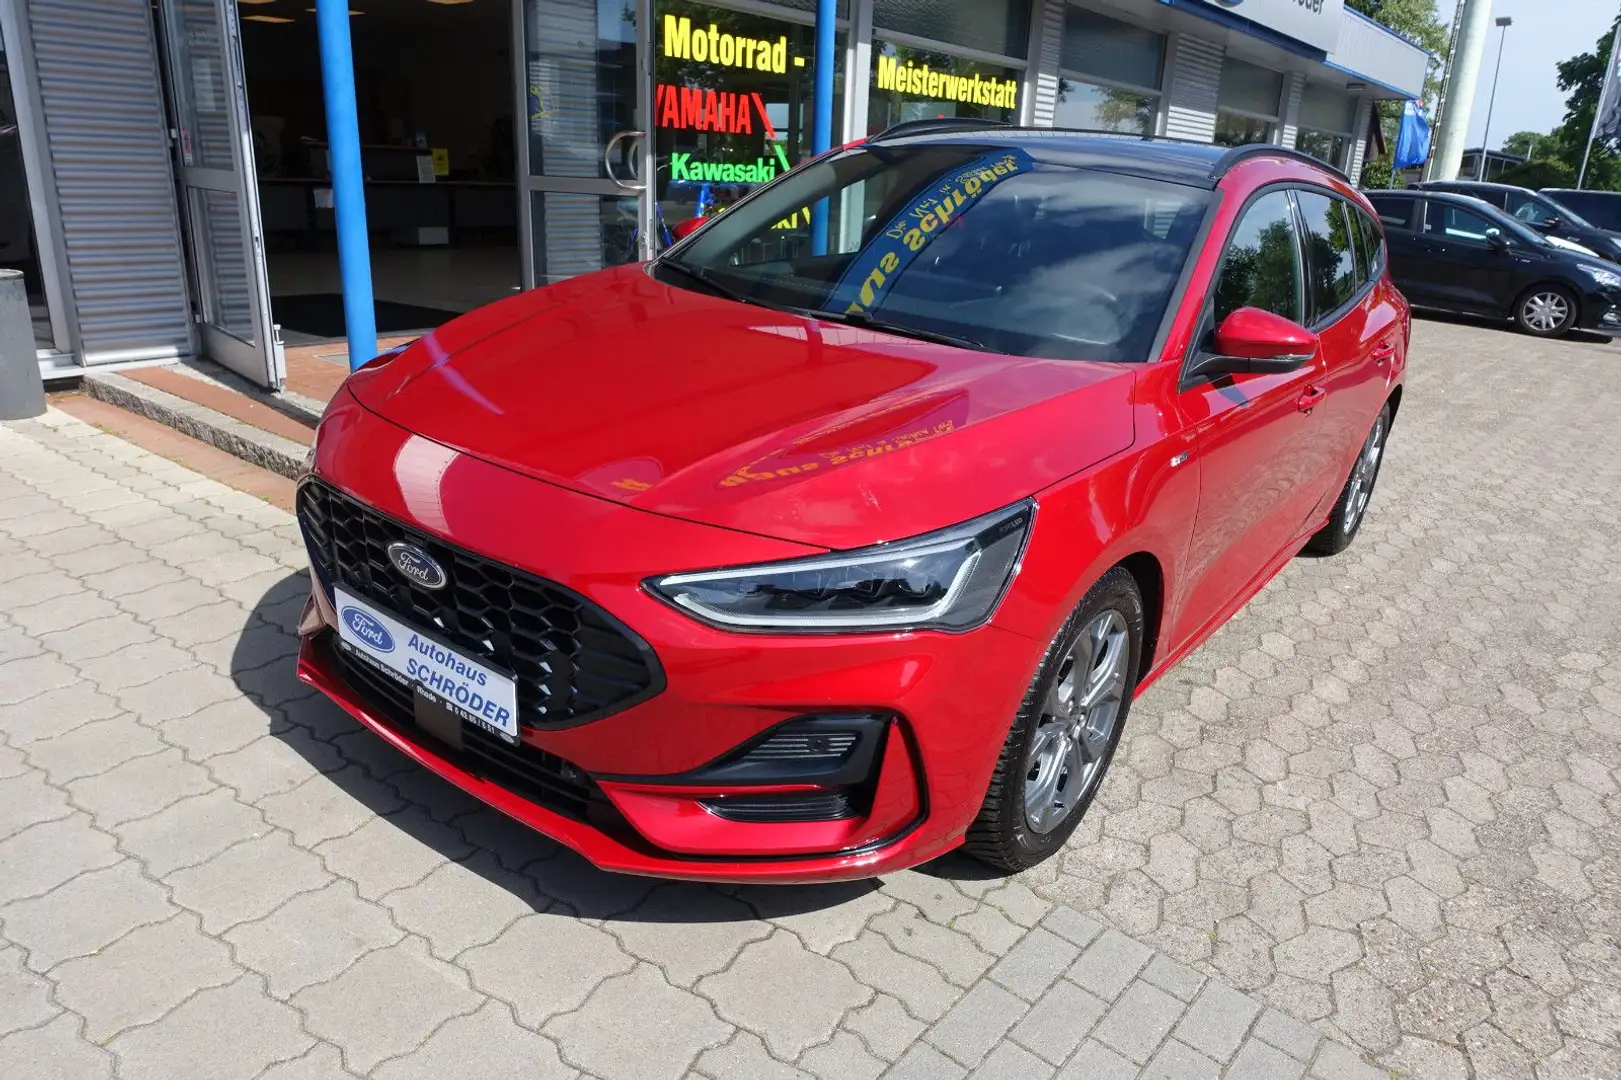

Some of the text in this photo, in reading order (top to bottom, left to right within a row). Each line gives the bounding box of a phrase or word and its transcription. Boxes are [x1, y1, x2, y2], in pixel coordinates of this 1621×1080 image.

[664, 14, 787, 74] Motorrad
[878, 55, 1017, 109] Meisterwerkstatt
[671, 152, 776, 183] Kawasaki
[398, 552, 430, 581] Ford
[351, 612, 384, 645] Ford
[407, 633, 488, 687] Autohaus
[406, 658, 510, 728] SCHRÖDER
